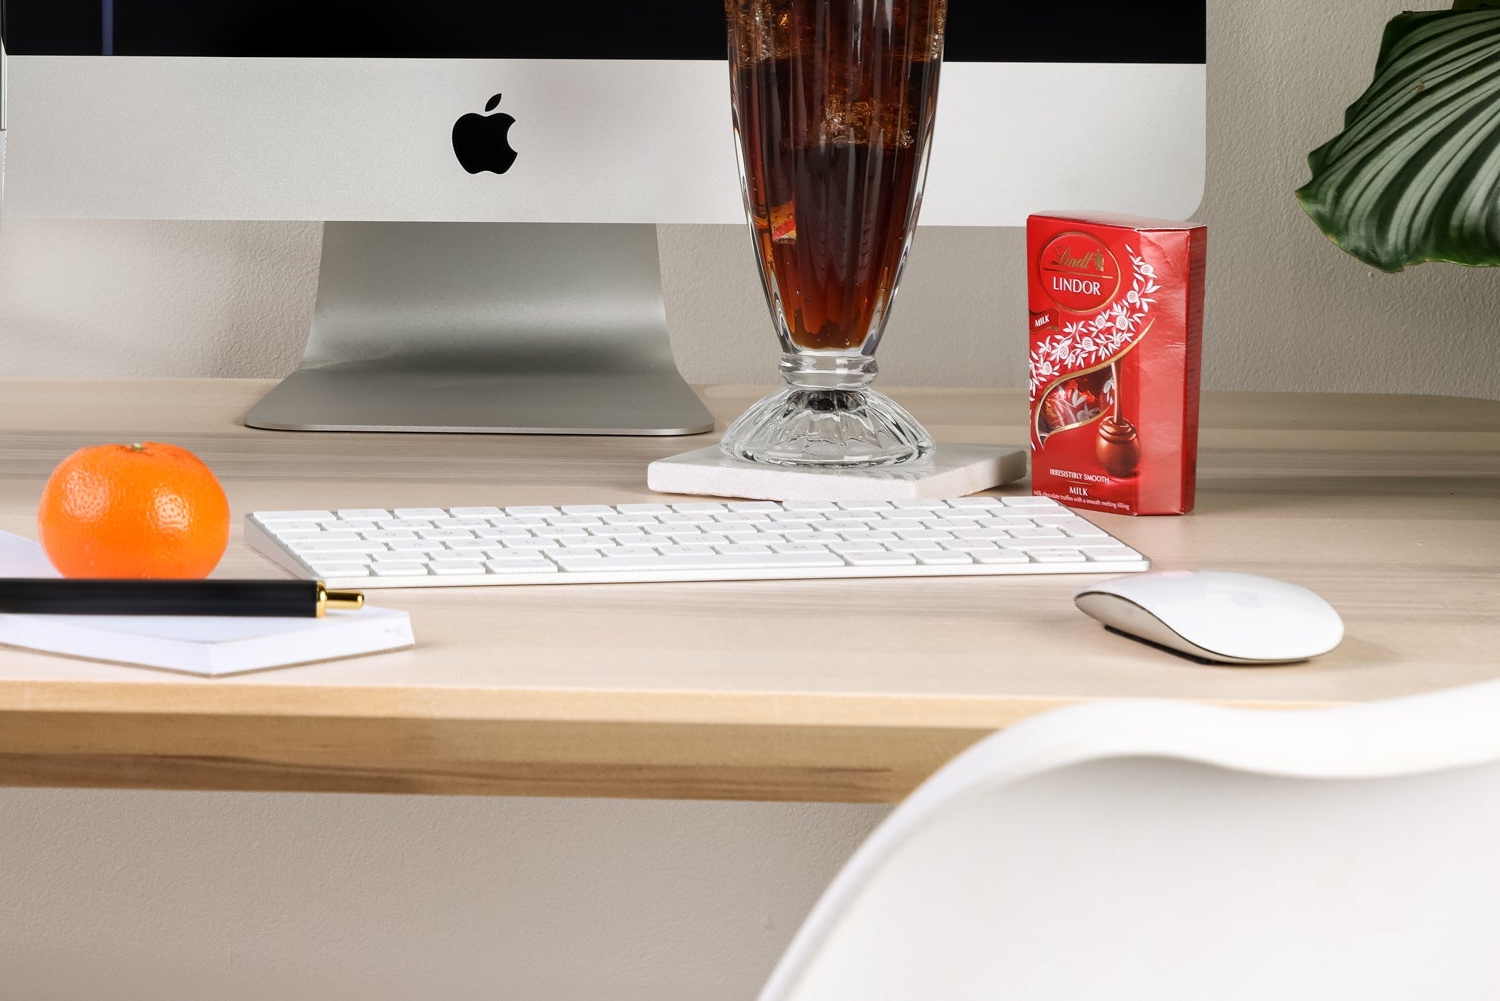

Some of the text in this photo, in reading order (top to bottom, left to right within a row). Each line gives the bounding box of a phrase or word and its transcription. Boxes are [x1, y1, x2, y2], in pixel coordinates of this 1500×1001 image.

[1051, 245, 1094, 269] Lindt
[1052, 276, 1101, 295] LINDOR
[1034, 314, 1051, 328] MILK
[1049, 468, 1110, 483] IRRESISTIBLY SMOOTH
[1069, 486, 1088, 497] MILK
[1101, 500, 1117, 509] melting
